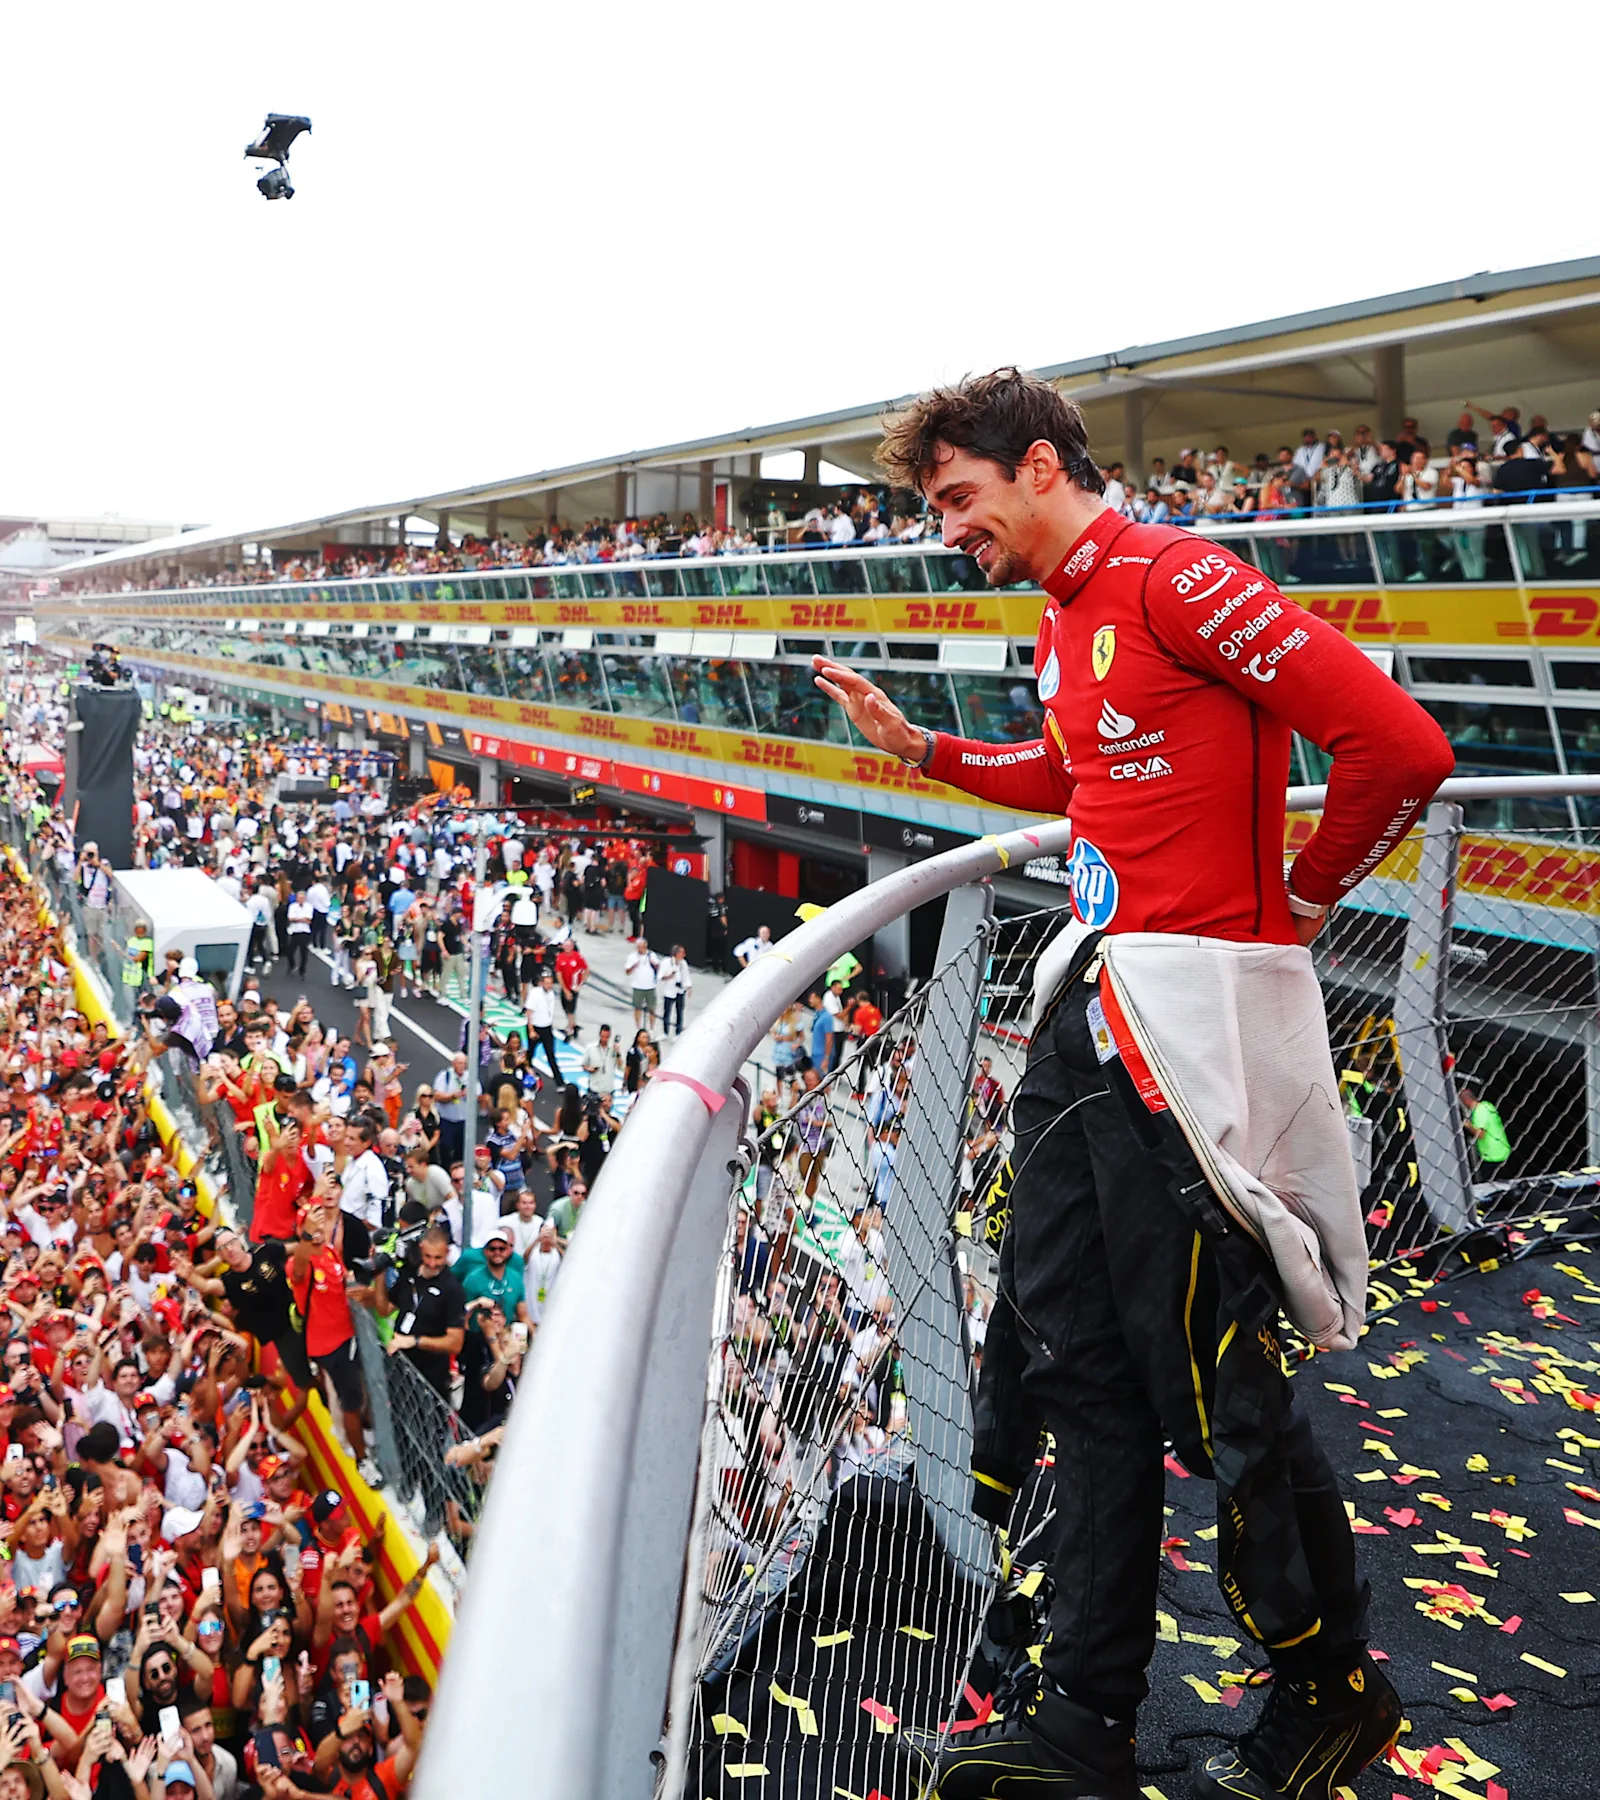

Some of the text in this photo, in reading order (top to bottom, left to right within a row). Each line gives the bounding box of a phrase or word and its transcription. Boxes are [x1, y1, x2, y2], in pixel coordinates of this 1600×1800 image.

[1063, 539, 1097, 576] PERONI
[1170, 553, 1228, 595] aws
[558, 605, 594, 622] DHL
[621, 604, 664, 624] DHL
[698, 604, 750, 626] DHL
[790, 603, 854, 628] DHL
[905, 602, 986, 629] DHL
[1196, 581, 1265, 640] Bitdefender
[1230, 600, 1285, 648] Palantir
[1305, 599, 1397, 634] HL
[1265, 627, 1309, 664] CELSIUS
[520, 706, 555, 727] DHL
[580, 715, 622, 738] DHL
[652, 726, 705, 752] DHL
[1098, 730, 1165, 755] Santander
[741, 740, 800, 769] DHL
[961, 744, 1047, 767] RICHARD MILLE
[851, 756, 933, 791] DHL
[1136, 768, 1173, 782] LOGISTICS
[1386, 798, 1420, 841] MILLE
[1339, 840, 1390, 887] RICHARD
